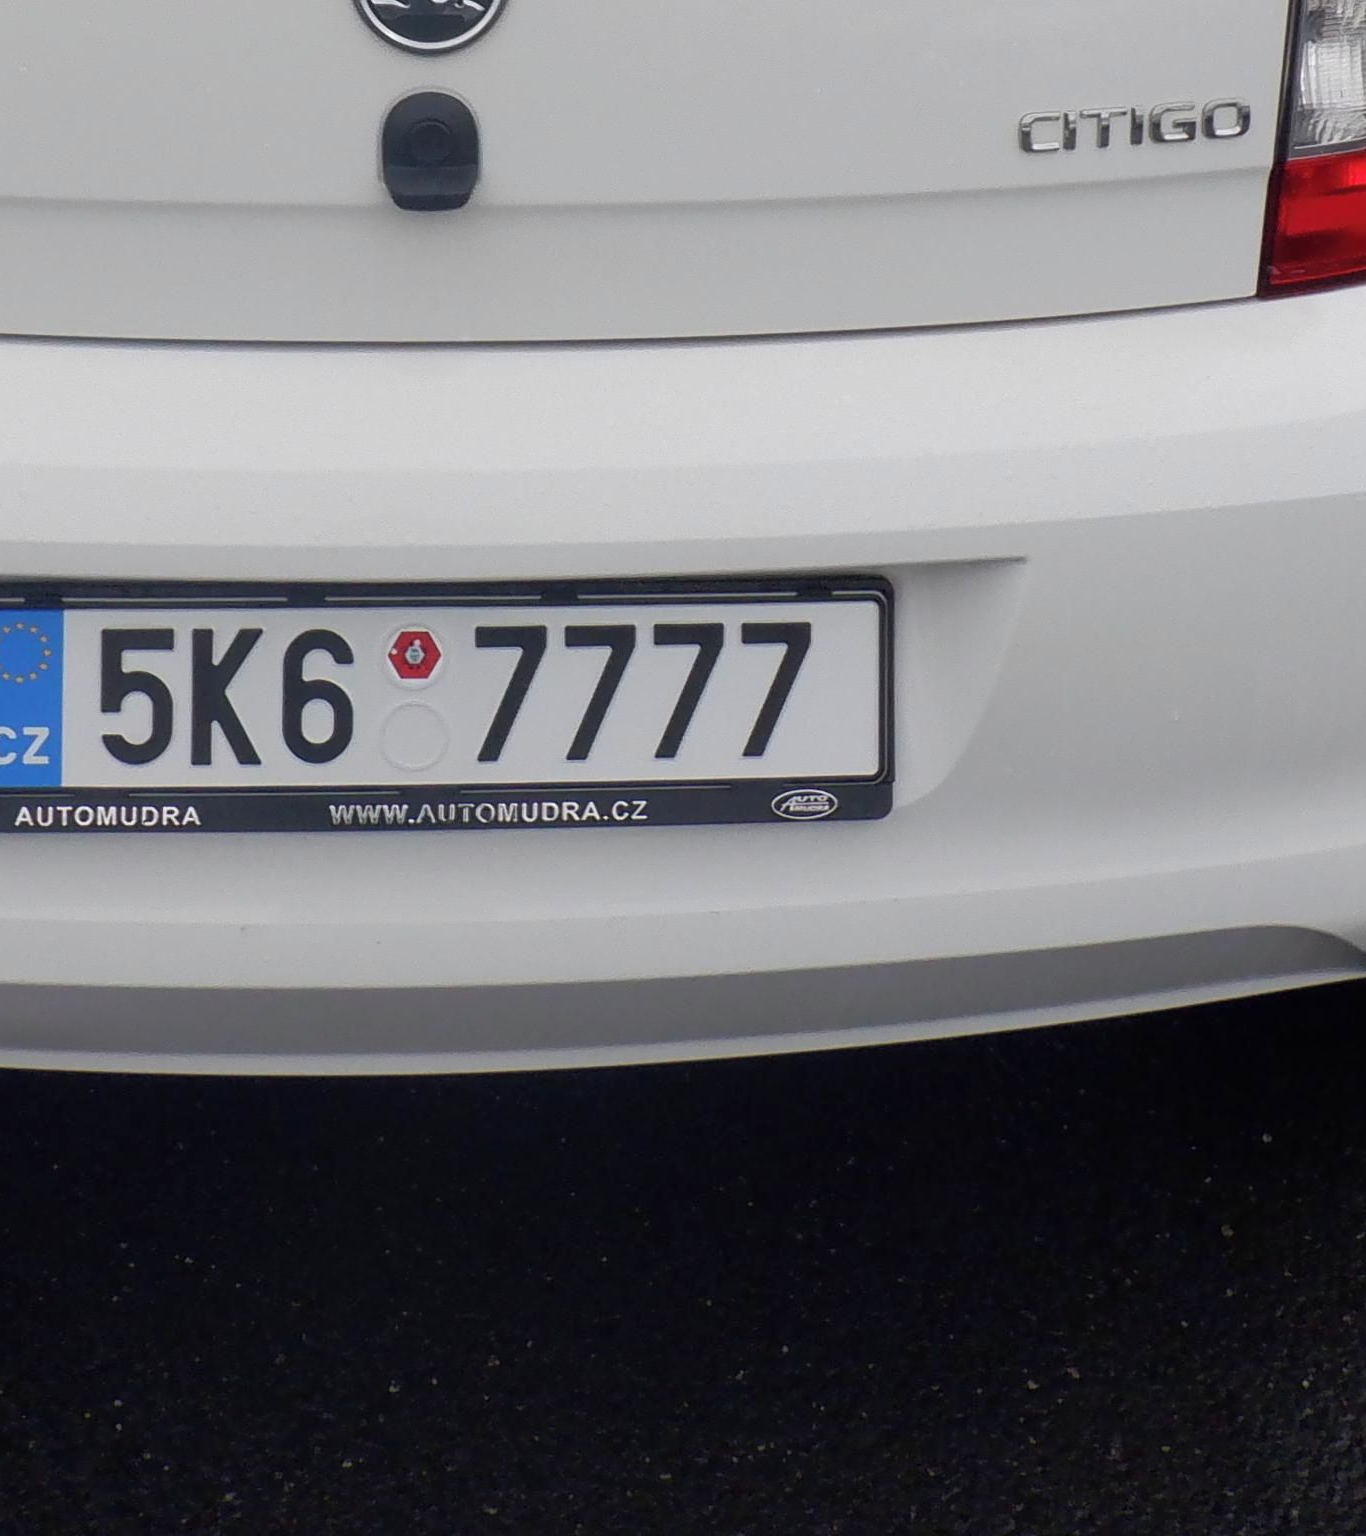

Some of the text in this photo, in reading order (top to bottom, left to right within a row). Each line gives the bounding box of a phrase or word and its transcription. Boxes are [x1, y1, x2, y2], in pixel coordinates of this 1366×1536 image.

[1018, 97, 1251, 153] CITIGO
[100, 621, 812, 765] 5K6 7777
[14, 805, 202, 826] AUTOMUDRA
[328, 800, 648, 825] WWW.AUTOMUDRA.CZ
